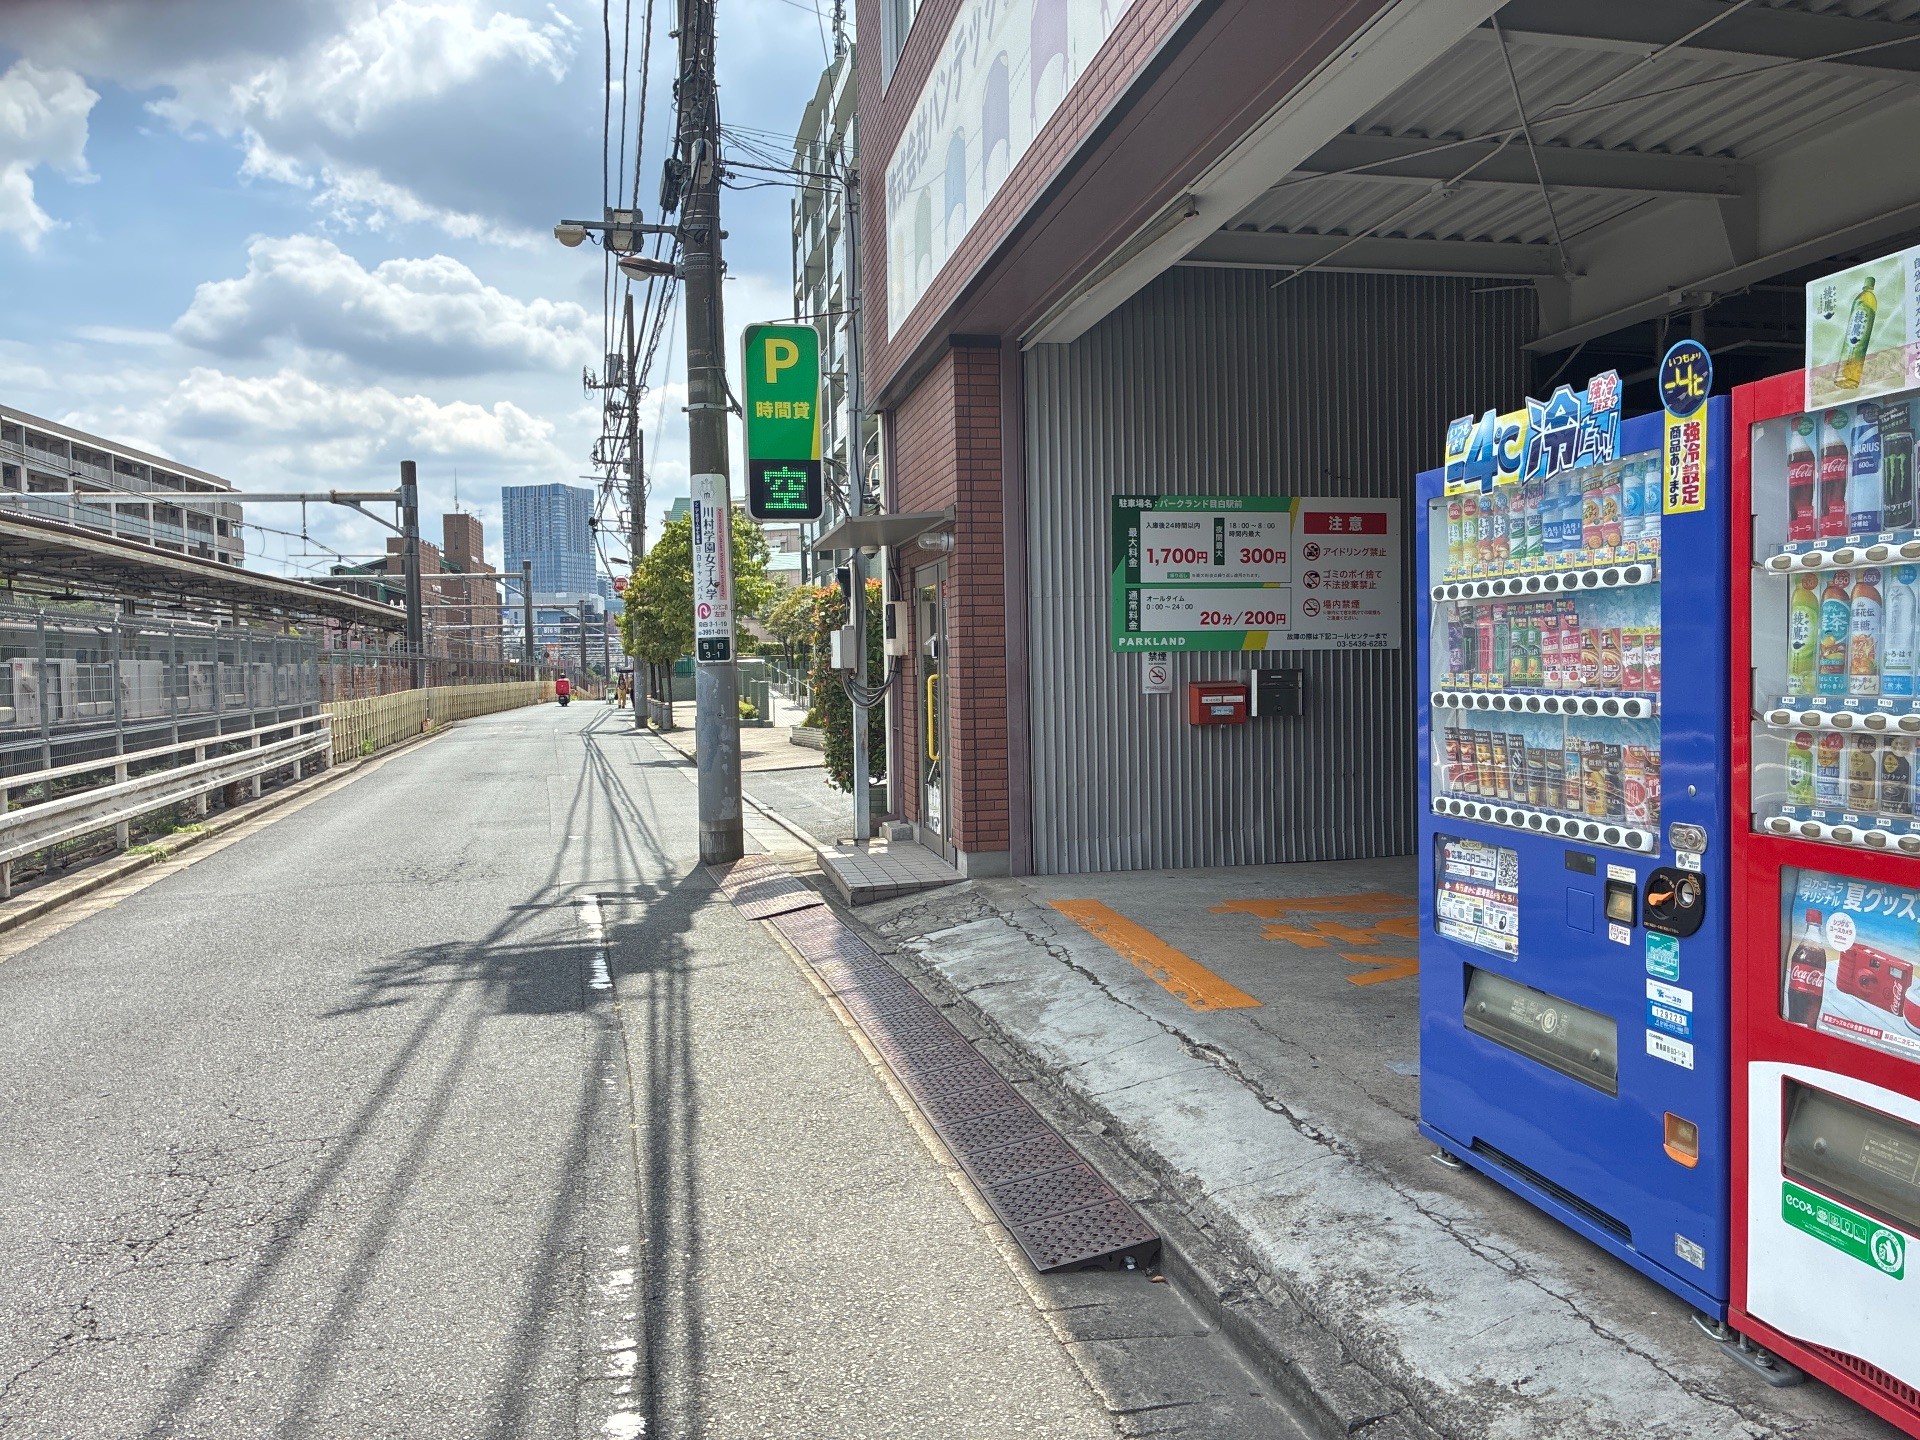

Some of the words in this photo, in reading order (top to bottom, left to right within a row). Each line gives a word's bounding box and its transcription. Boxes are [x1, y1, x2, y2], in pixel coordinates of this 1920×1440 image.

[764, 338, 799, 384] P
[1669, 352, 1702, 368] いつもより
[756, 401, 810, 420] 時間貸
[1669, 426, 1682, 508] 商品あります
[1682, 422, 1700, 506] 強冷設定
[764, 466, 808, 510] 空
[1328, 515, 1363, 531] 注意
[1128, 527, 1138, 568] 最大料金
[1215, 526, 1224, 558] 夜間最大
[703, 507, 717, 600] 川村学園女子大学
[1146, 548, 1208, 566] 1,700円
[1240, 548, 1287, 564] 300円
[1323, 547, 1387, 557] アイドリング禁止
[695, 546, 703, 600] 目白キャンパス
[1323, 570, 1383, 579] ゴミのポイ捨て
[1323, 580, 1377, 590] 不法投棄禁止
[1128, 590, 1138, 631] 通常料金
[1323, 600, 1360, 609] 場内禁煙
[1118, 637, 1186, 647] PARKLAND
[1287, 632, 1388, 640] 故障の際は下記コールセンターまで
[1148, 651, 1167, 662] 禁煙
[1802, 890, 1840, 907] オリジナル
[1843, 881, 1920, 923] 夏グッズ
[1655, 1008, 1683, 1024] 129223
